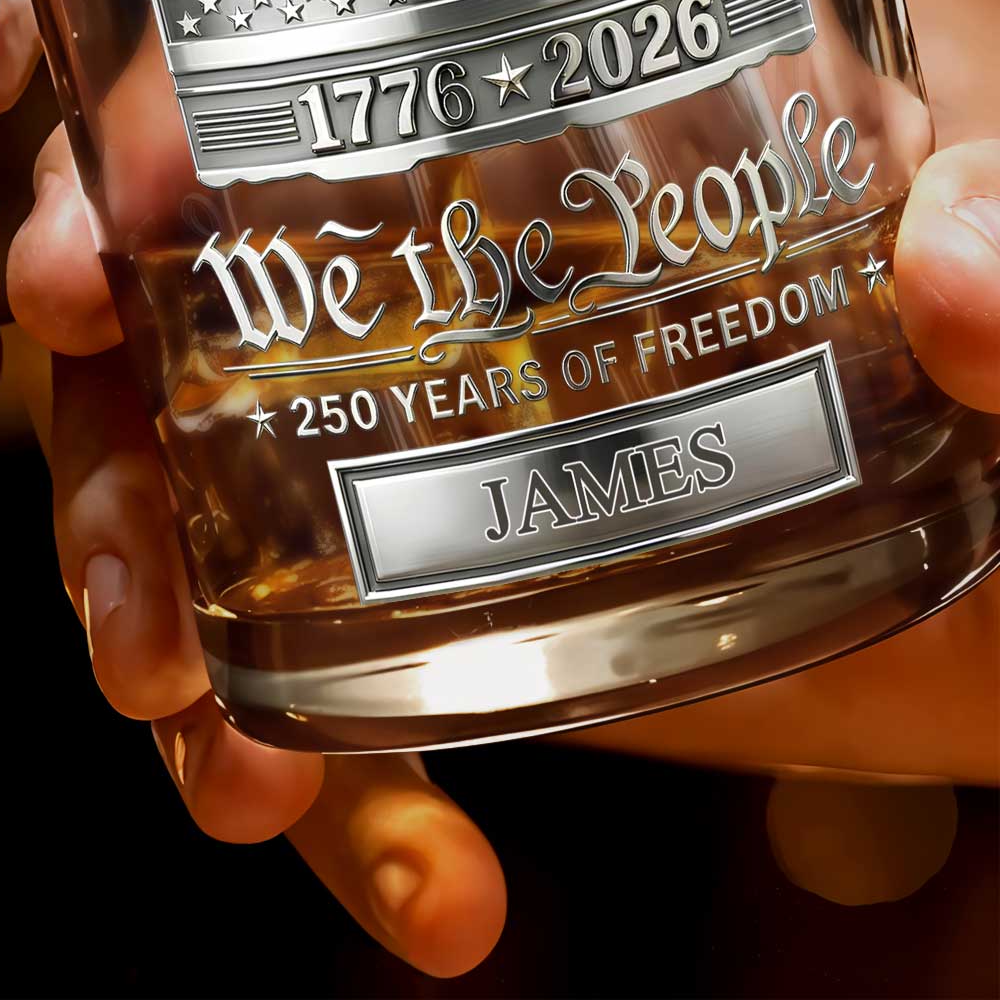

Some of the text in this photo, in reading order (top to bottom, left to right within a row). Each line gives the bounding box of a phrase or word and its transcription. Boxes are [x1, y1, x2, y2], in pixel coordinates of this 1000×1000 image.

[298, 61, 477, 155] 1776
[392, 198, 574, 364] the
[560, 91, 875, 315] People
[288, 265, 850, 438] 250 YEARS OF FREEDOM
[480, 422, 736, 543] JAMES
